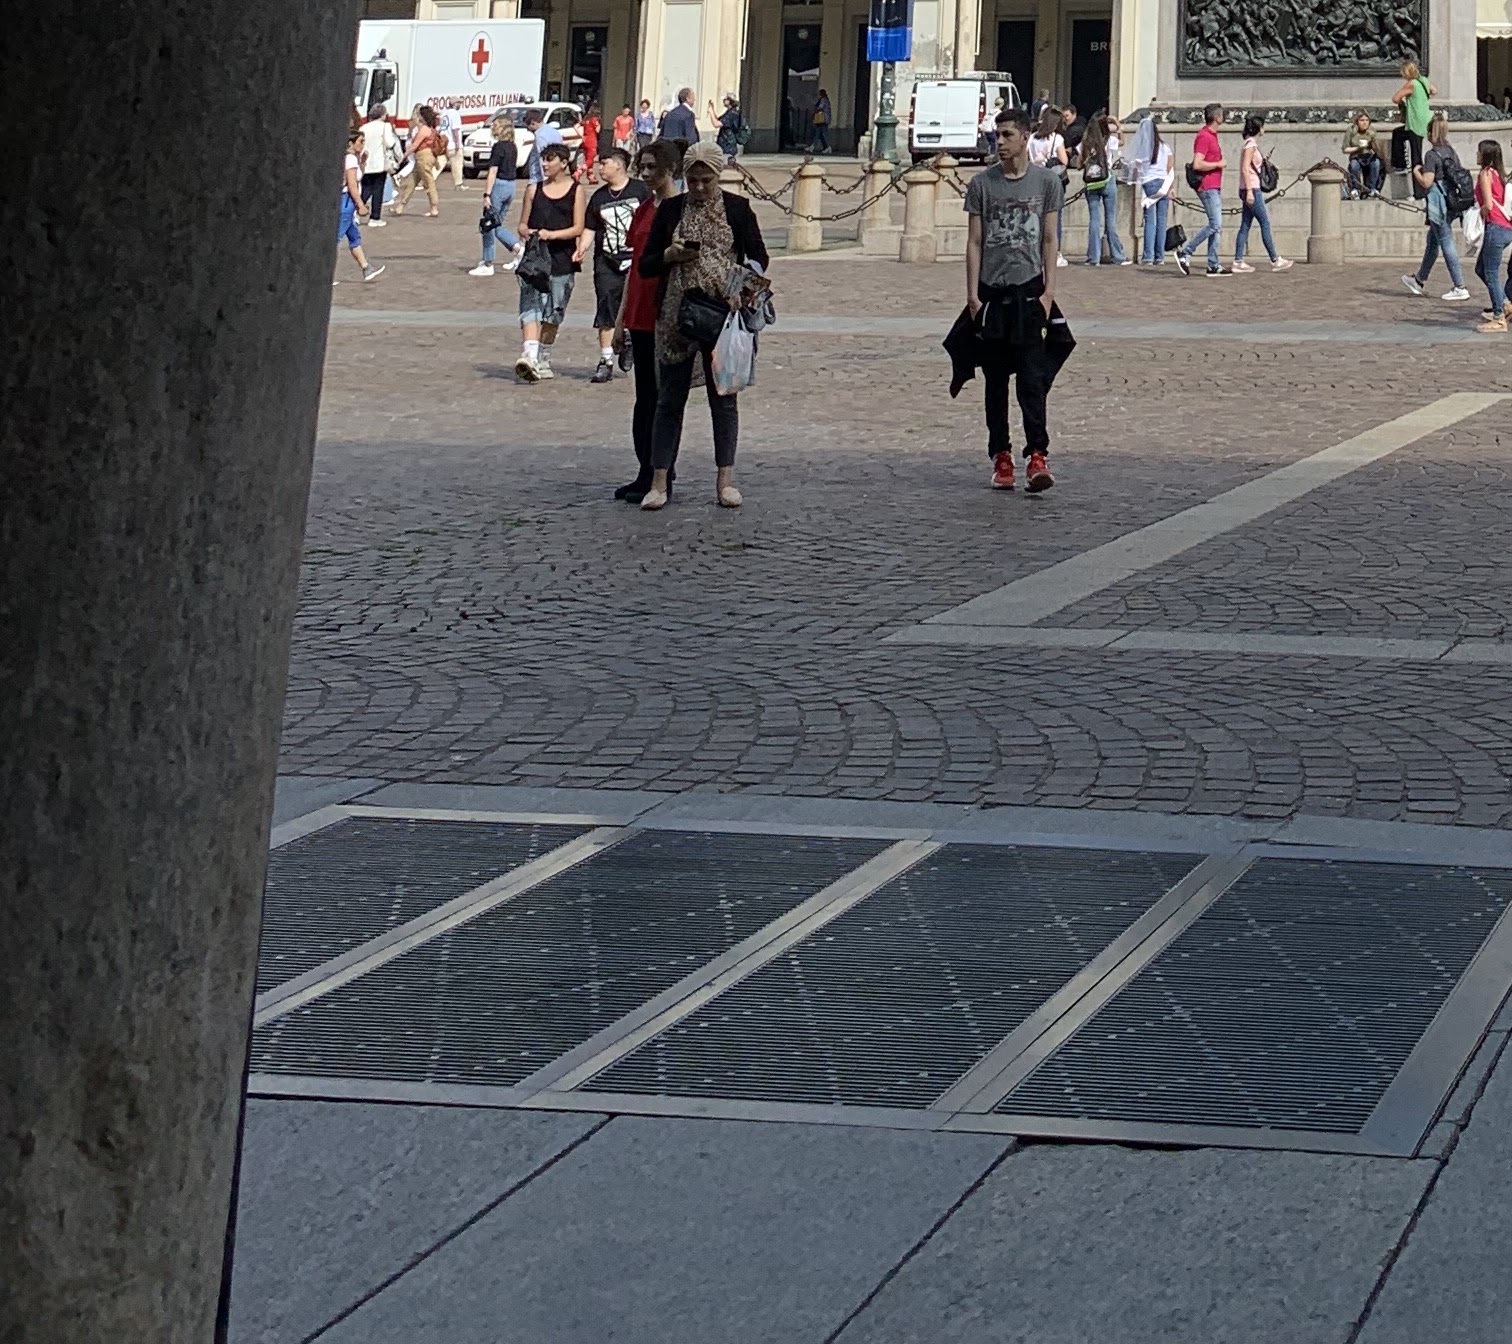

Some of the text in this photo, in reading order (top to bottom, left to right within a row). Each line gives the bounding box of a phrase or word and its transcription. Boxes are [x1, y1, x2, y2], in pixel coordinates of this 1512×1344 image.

[1090, 41, 1111, 52] BR
[427, 96, 456, 110] CROC
[460, 94, 487, 109] ROSSA
